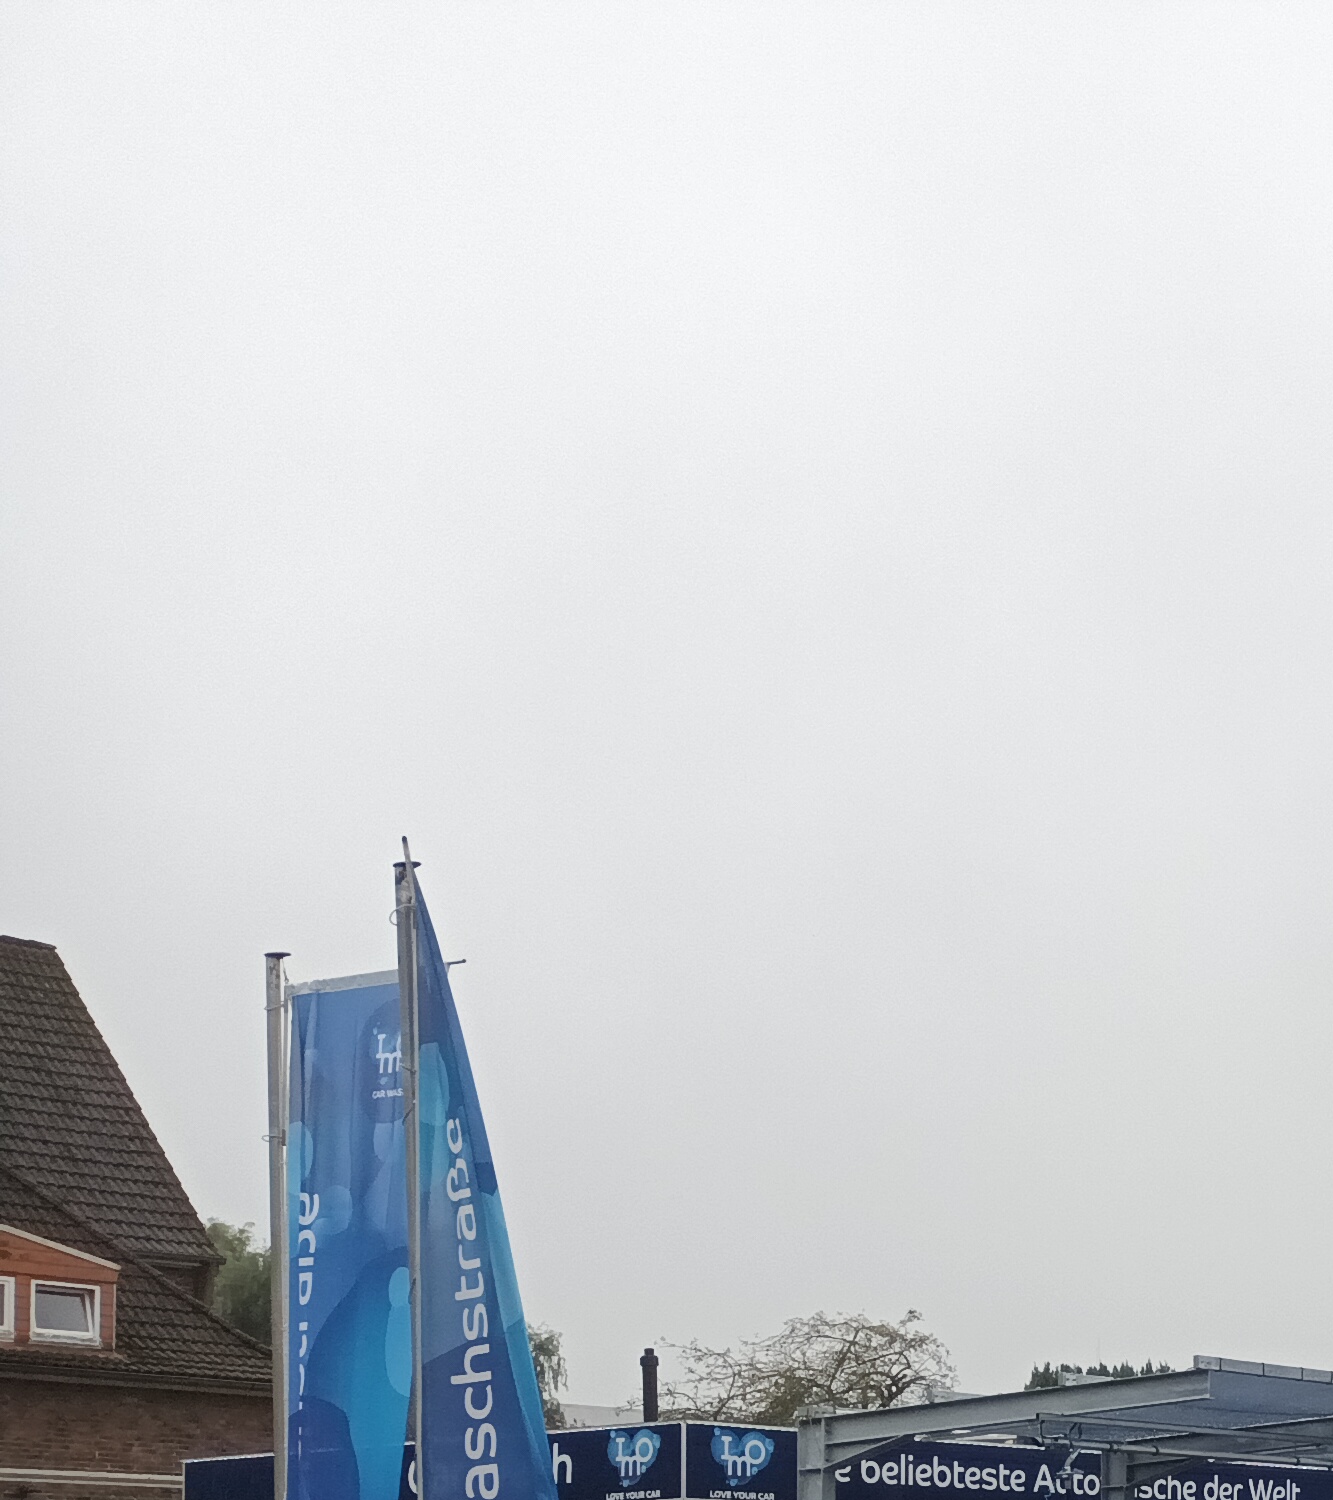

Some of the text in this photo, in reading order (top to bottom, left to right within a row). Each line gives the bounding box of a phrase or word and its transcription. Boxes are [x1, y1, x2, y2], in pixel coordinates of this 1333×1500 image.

[387, 1088, 404, 1097] WAS
[860, 1453, 1026, 1492] beliebteste
[605, 1489, 661, 1500] LOVE YOUR CAR
[710, 1489, 775, 1500] LOVE YOUR CAR
